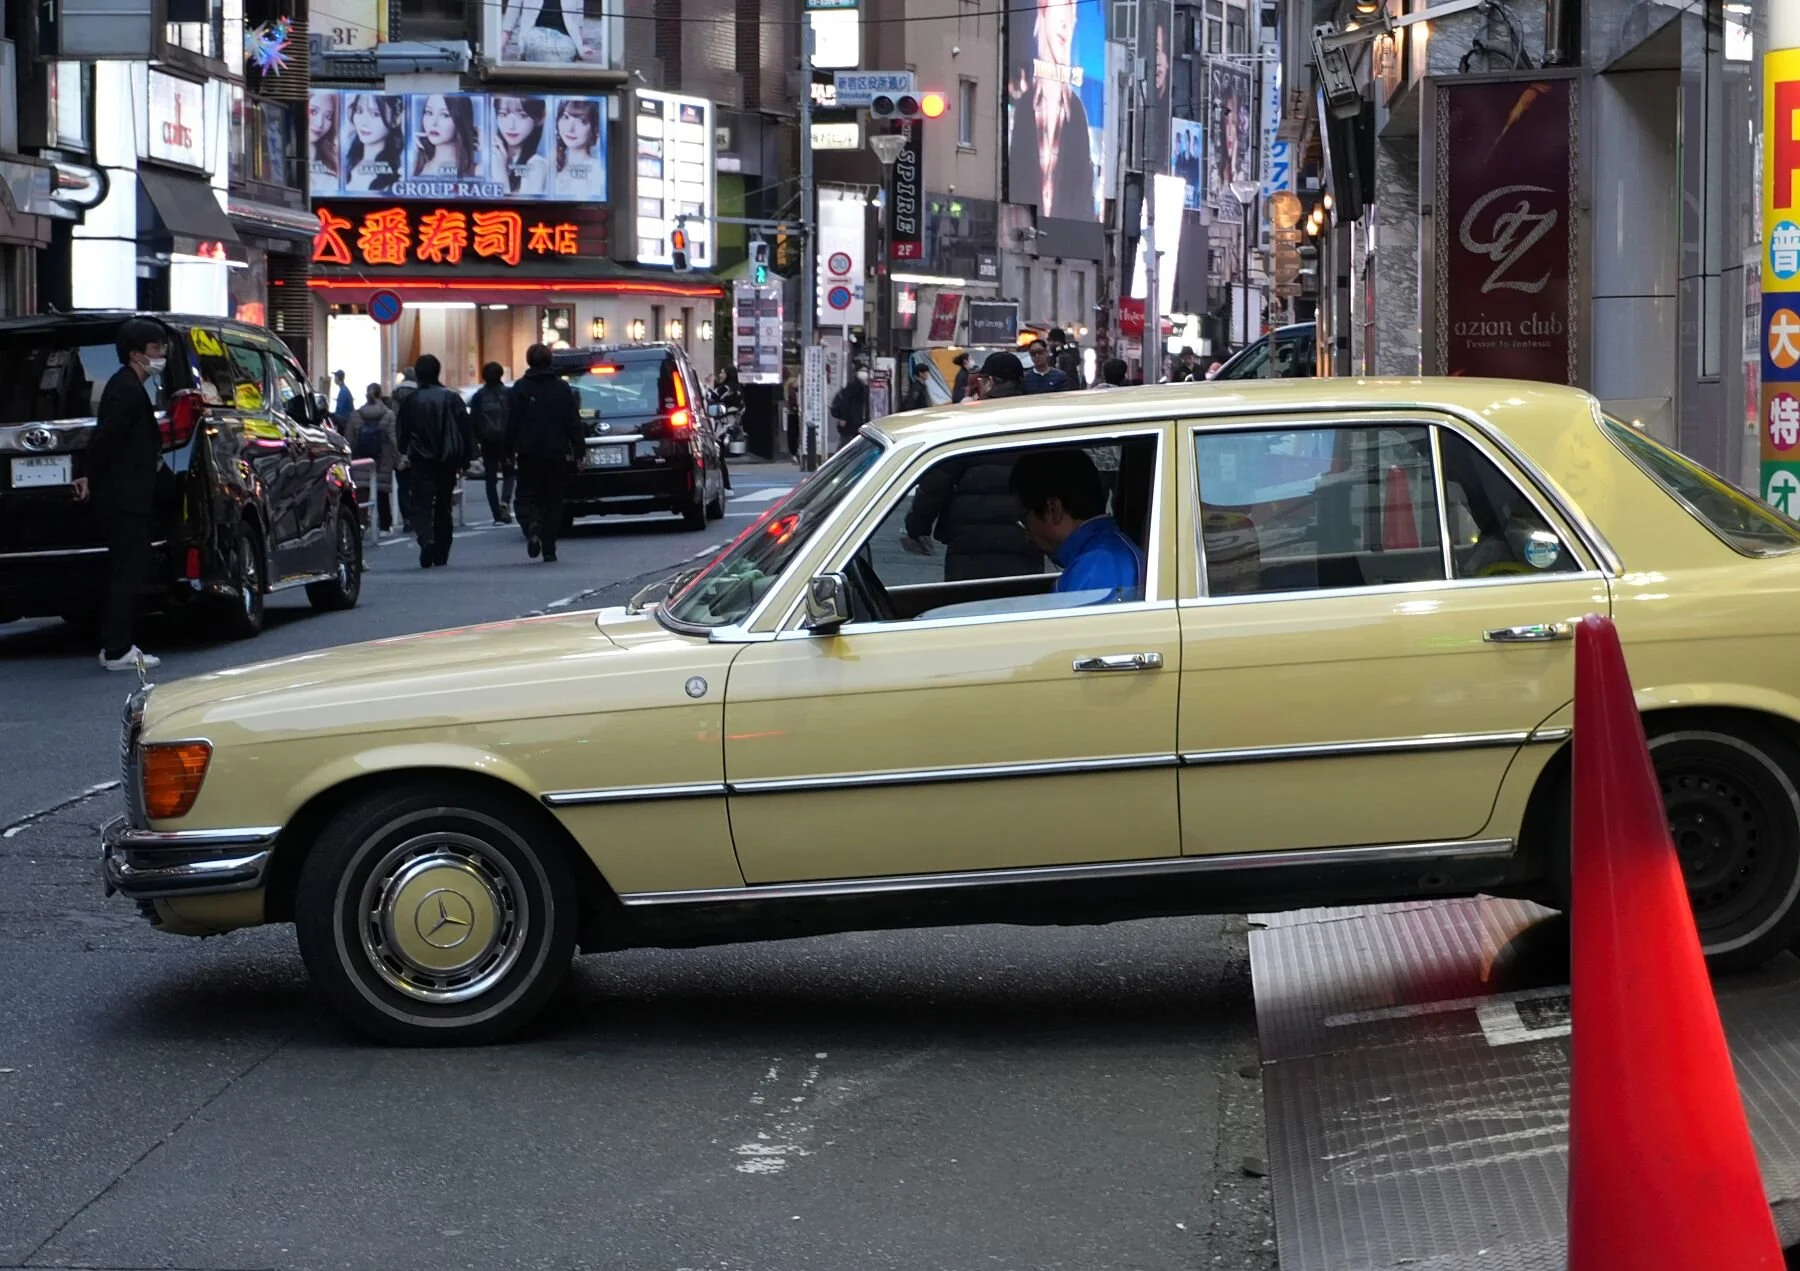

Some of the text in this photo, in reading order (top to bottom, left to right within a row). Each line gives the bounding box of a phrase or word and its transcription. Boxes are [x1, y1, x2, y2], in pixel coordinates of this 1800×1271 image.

[333, 27, 359, 46] 3F
[391, 182, 504, 198] GROUP RACE
[896, 149, 916, 235] SPIRE
[528, 222, 578, 255] 本店
[897, 244, 914, 256] 2F
[833, 257, 848, 270] 30
[1454, 311, 1563, 336] azian club
[1772, 314, 1800, 358] 大
[1771, 397, 1800, 445] 特
